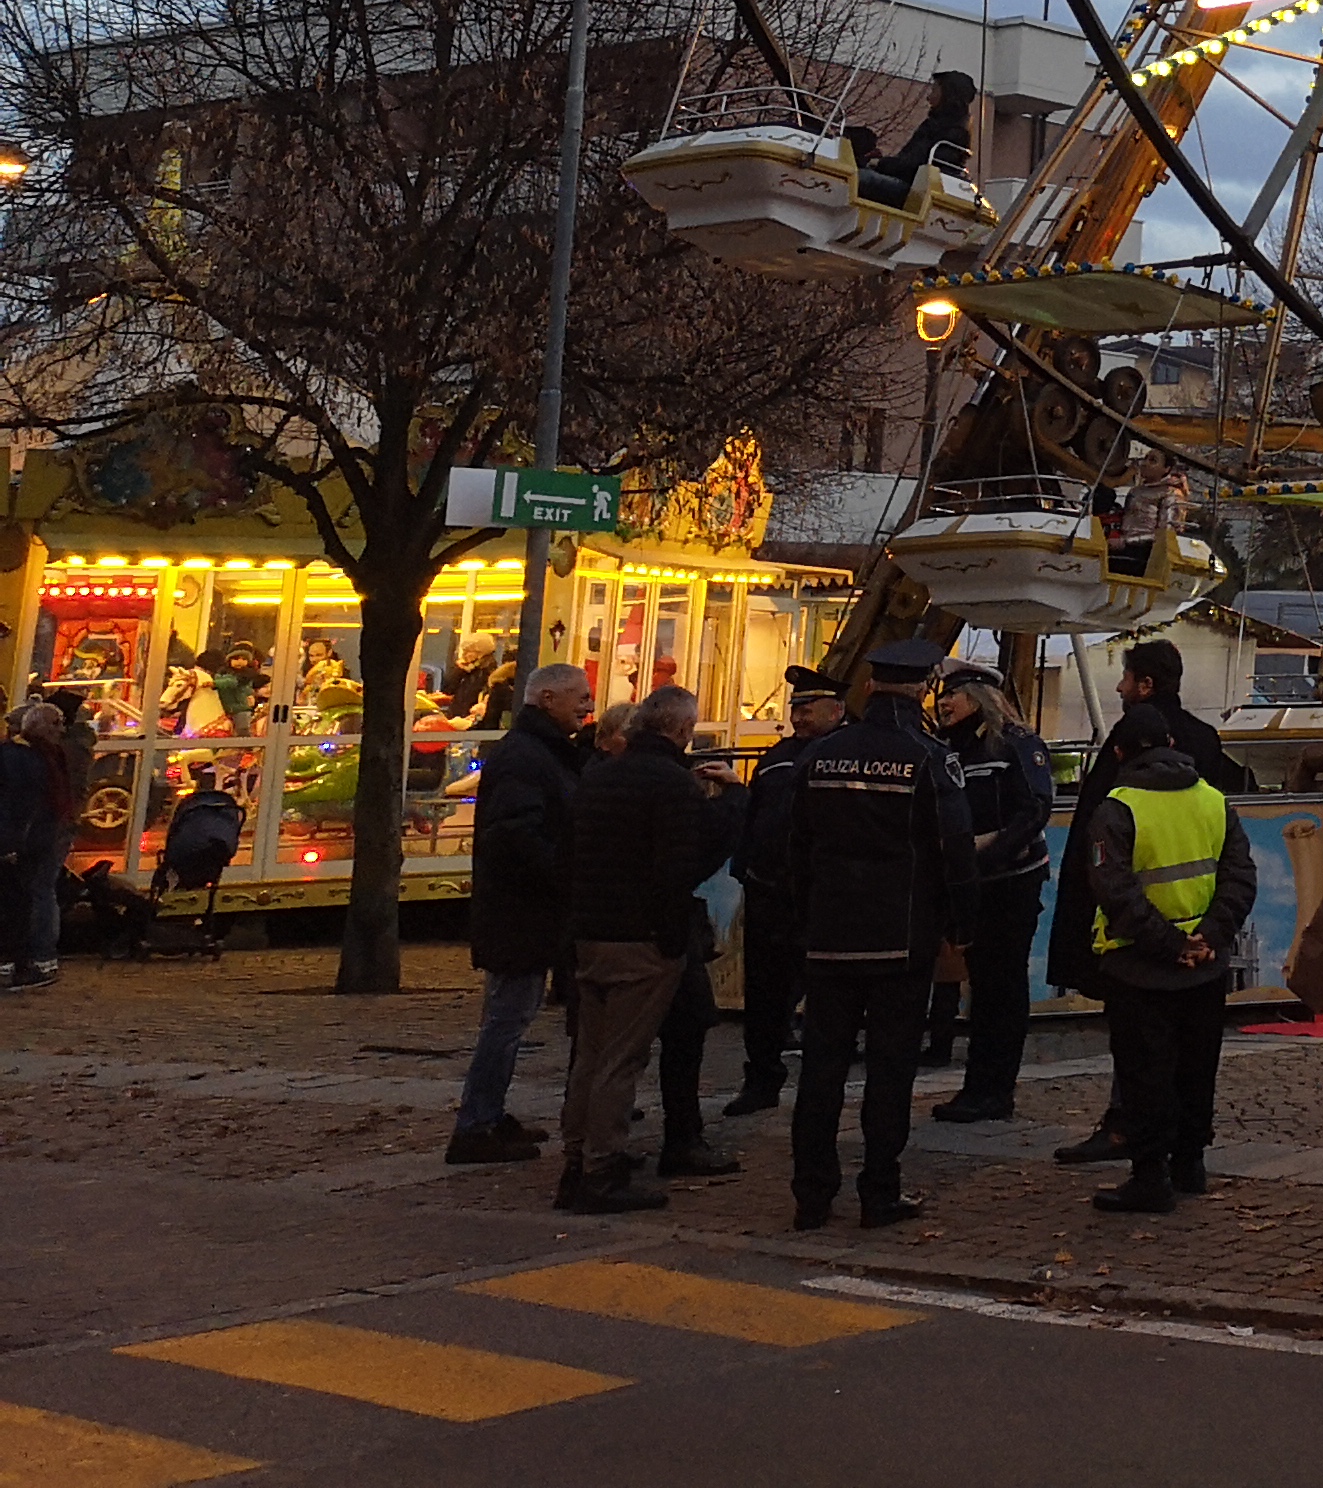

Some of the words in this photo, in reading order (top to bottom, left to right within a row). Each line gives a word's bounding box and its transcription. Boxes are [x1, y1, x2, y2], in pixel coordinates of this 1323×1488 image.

[533, 507, 572, 522] EXIT
[815, 760, 860, 773] POLIZIA
[863, 761, 914, 777] LOCALE
